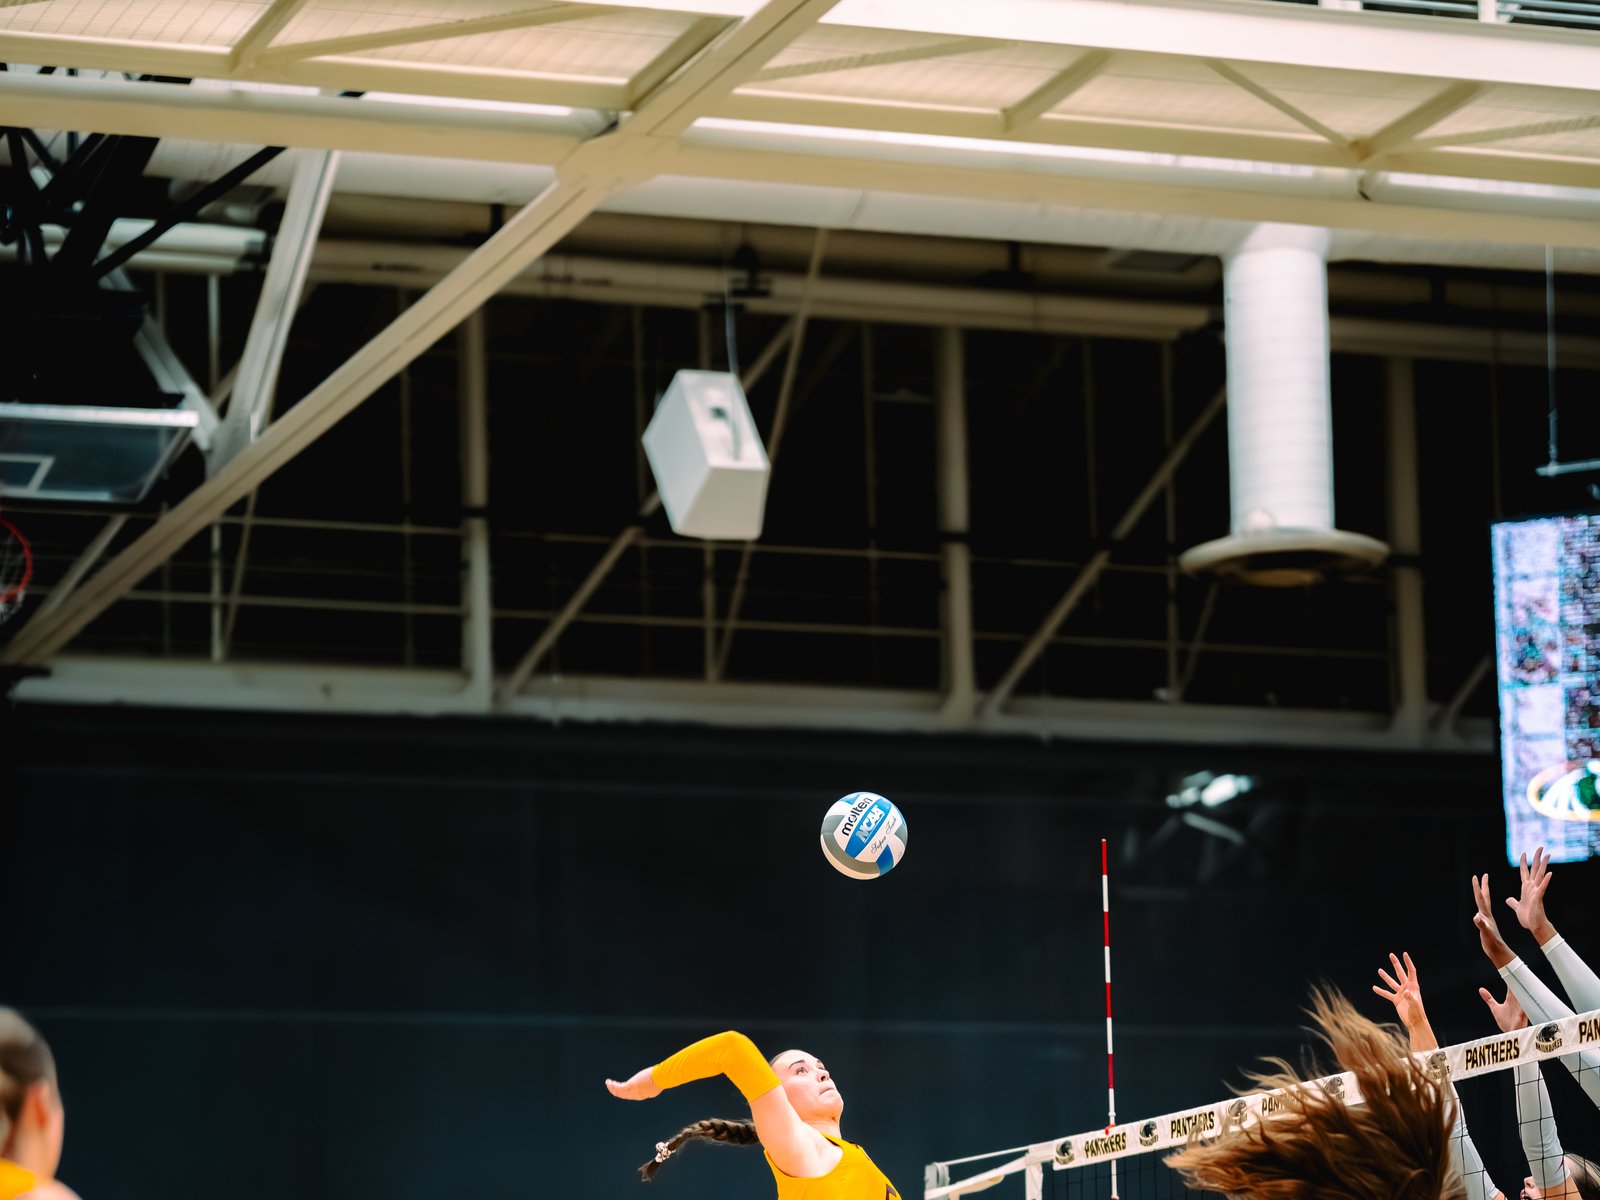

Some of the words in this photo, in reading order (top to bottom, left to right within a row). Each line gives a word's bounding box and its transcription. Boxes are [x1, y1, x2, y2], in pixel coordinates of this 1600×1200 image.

[841, 797, 873, 836] molten
[855, 804, 885, 843] NCAA
[1465, 1037, 1520, 1070] PANTHERS
[1084, 1132, 1127, 1158] PANTHERS
